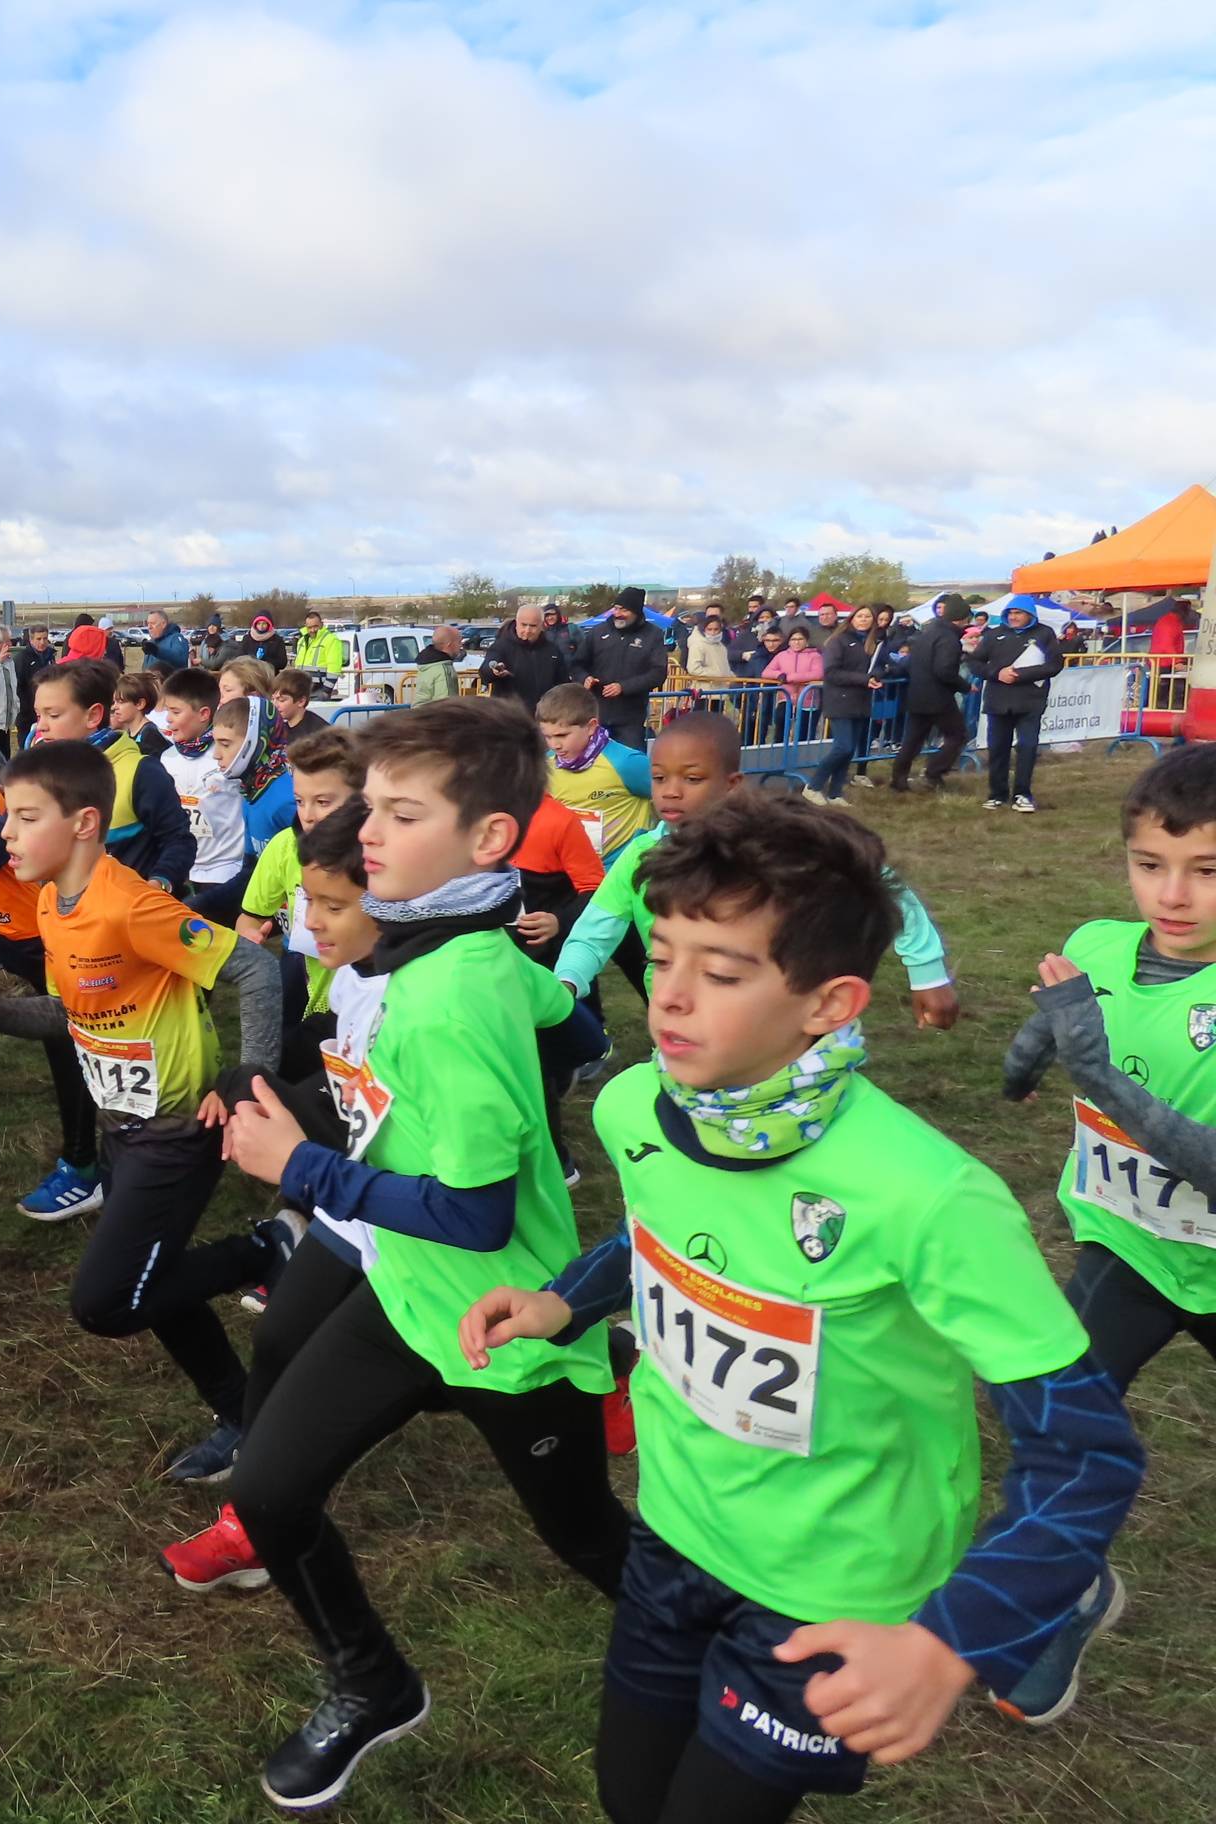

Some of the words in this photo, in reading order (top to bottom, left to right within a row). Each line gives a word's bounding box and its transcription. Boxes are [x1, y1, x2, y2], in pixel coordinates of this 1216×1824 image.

[1040, 714, 1101, 732] Salamanca
[1046, 691, 1092, 708] utación
[1092, 1142, 1216, 1215] 117
[648, 1282, 801, 1415] 1172
[740, 1701, 841, 1755] PATRICK
